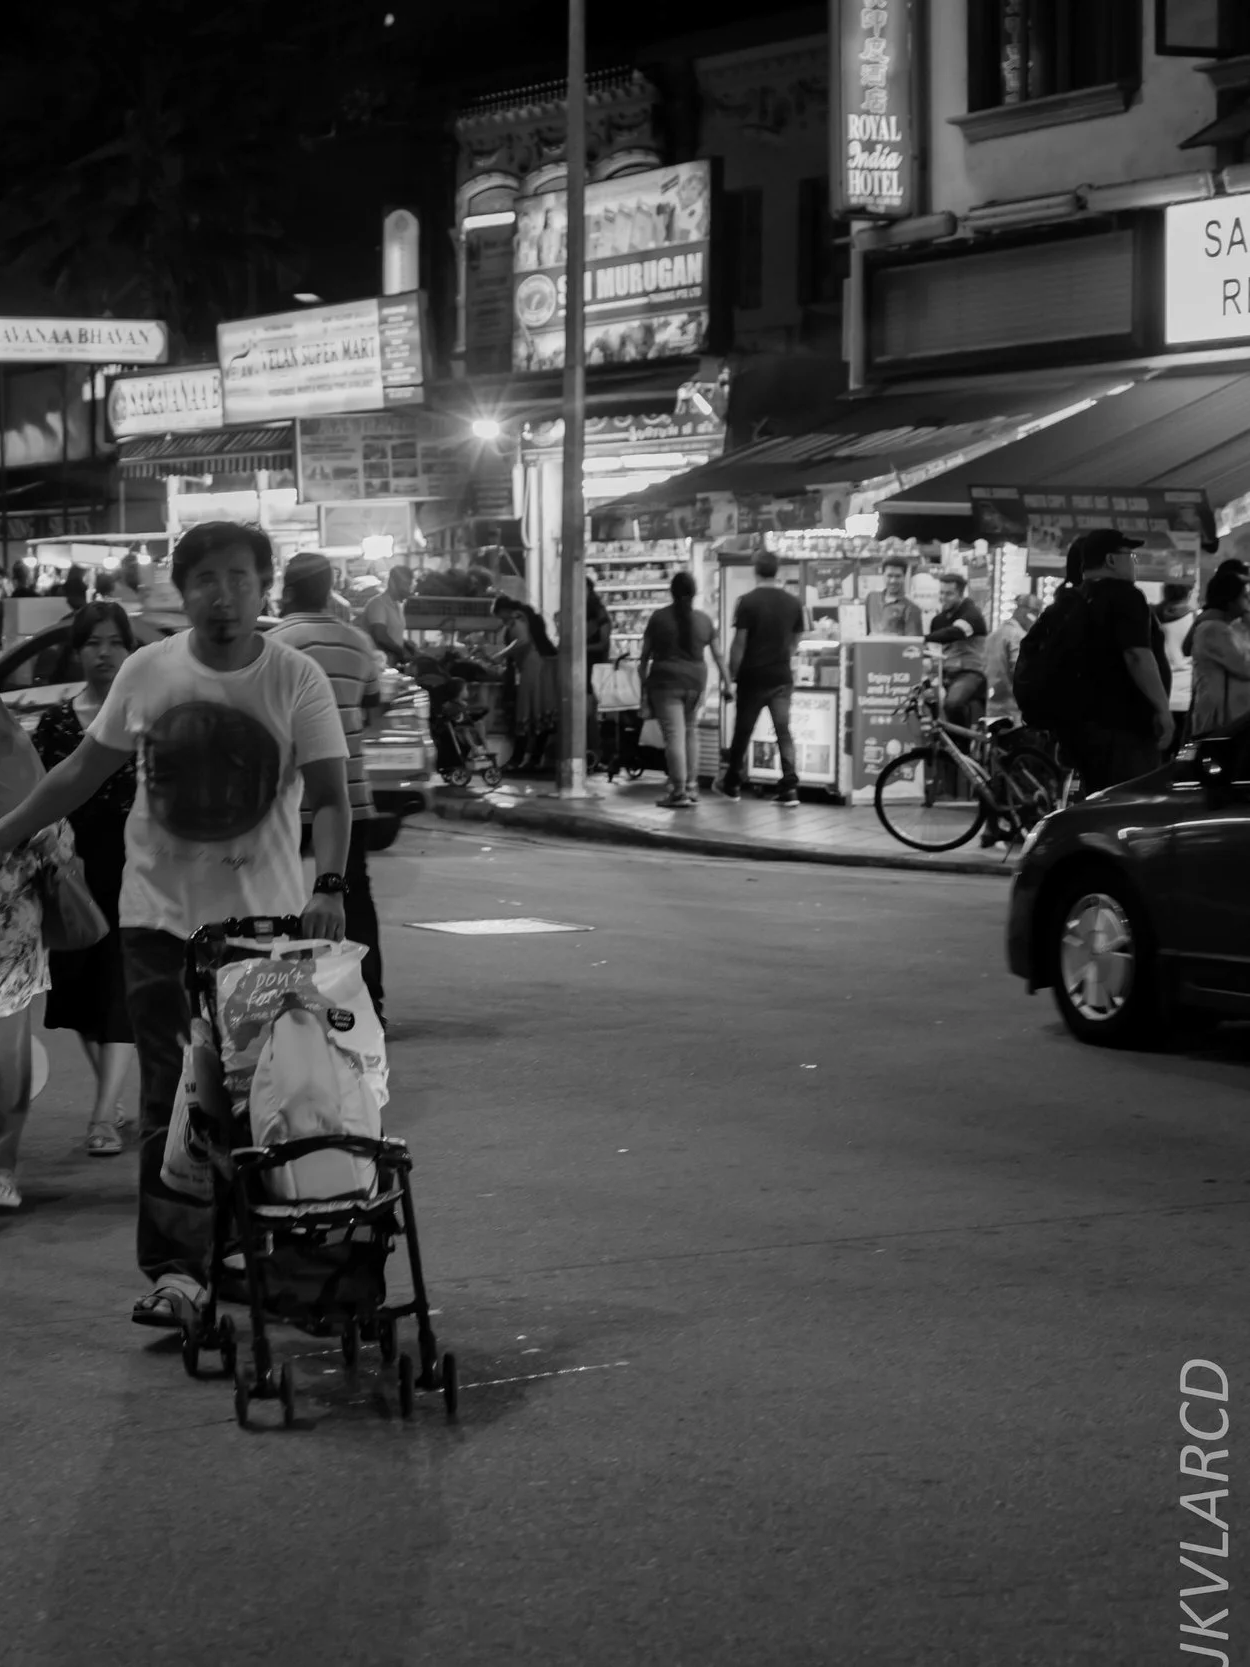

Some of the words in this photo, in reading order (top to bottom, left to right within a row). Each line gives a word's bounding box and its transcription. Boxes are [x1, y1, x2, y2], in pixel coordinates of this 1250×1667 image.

[848, 114, 902, 142] ROYAL
[848, 141, 903, 170] India
[848, 170, 904, 196] HOTEL
[557, 270, 592, 306] SI
[596, 252, 703, 300] MURUGAN
[1222, 277, 1250, 316] R
[77, 327, 151, 346] BHAVAN
[341, 335, 376, 361] MART
